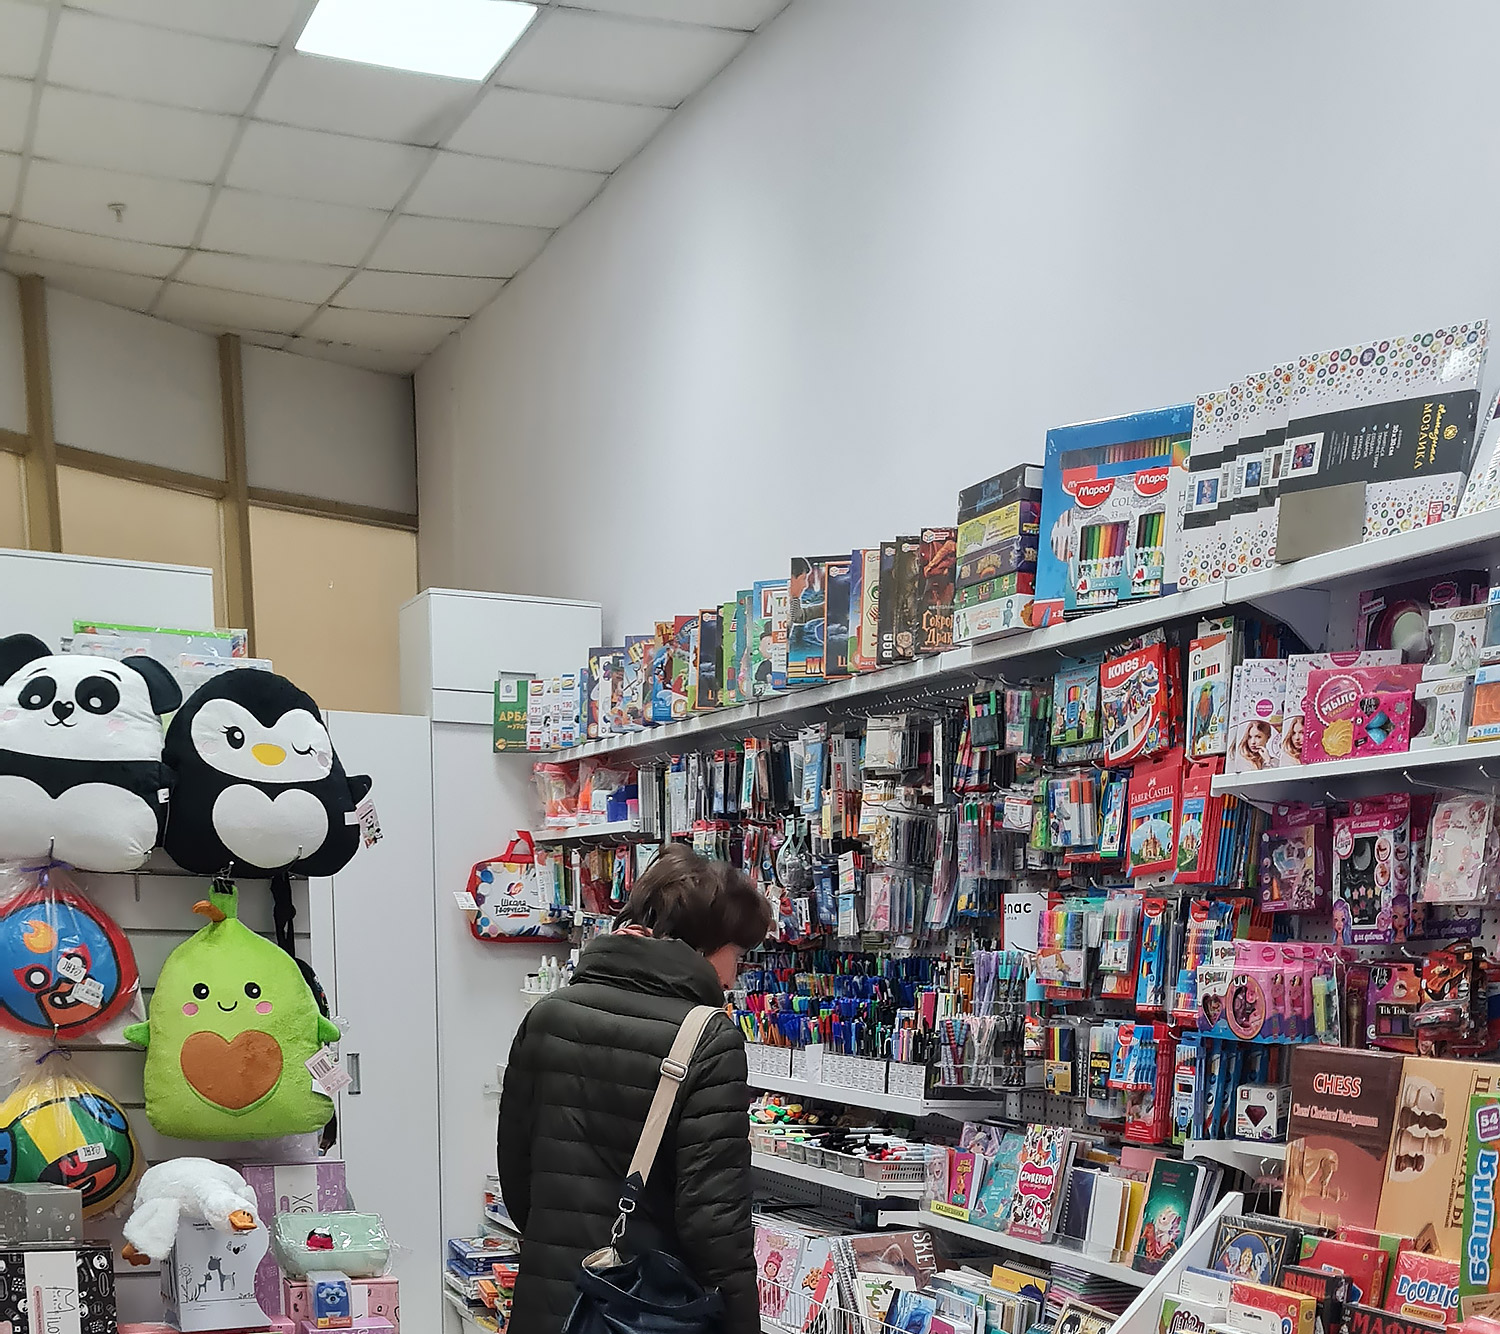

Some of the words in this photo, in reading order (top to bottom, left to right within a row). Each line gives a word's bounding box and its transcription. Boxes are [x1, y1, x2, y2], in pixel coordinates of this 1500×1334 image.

[1414, 402, 1434, 470] МОЗАИКА
[1077, 482, 1112, 498] Maped
[1320, 691, 1358, 716] МЫЛО
[500, 898, 527, 907] Школа
[1379, 1006, 1391, 1015] Tik
[1313, 1072, 1362, 1098] CHESS
[1480, 1112, 1499, 1127] 54
[1397, 1276, 1460, 1308] DOOBLIO
